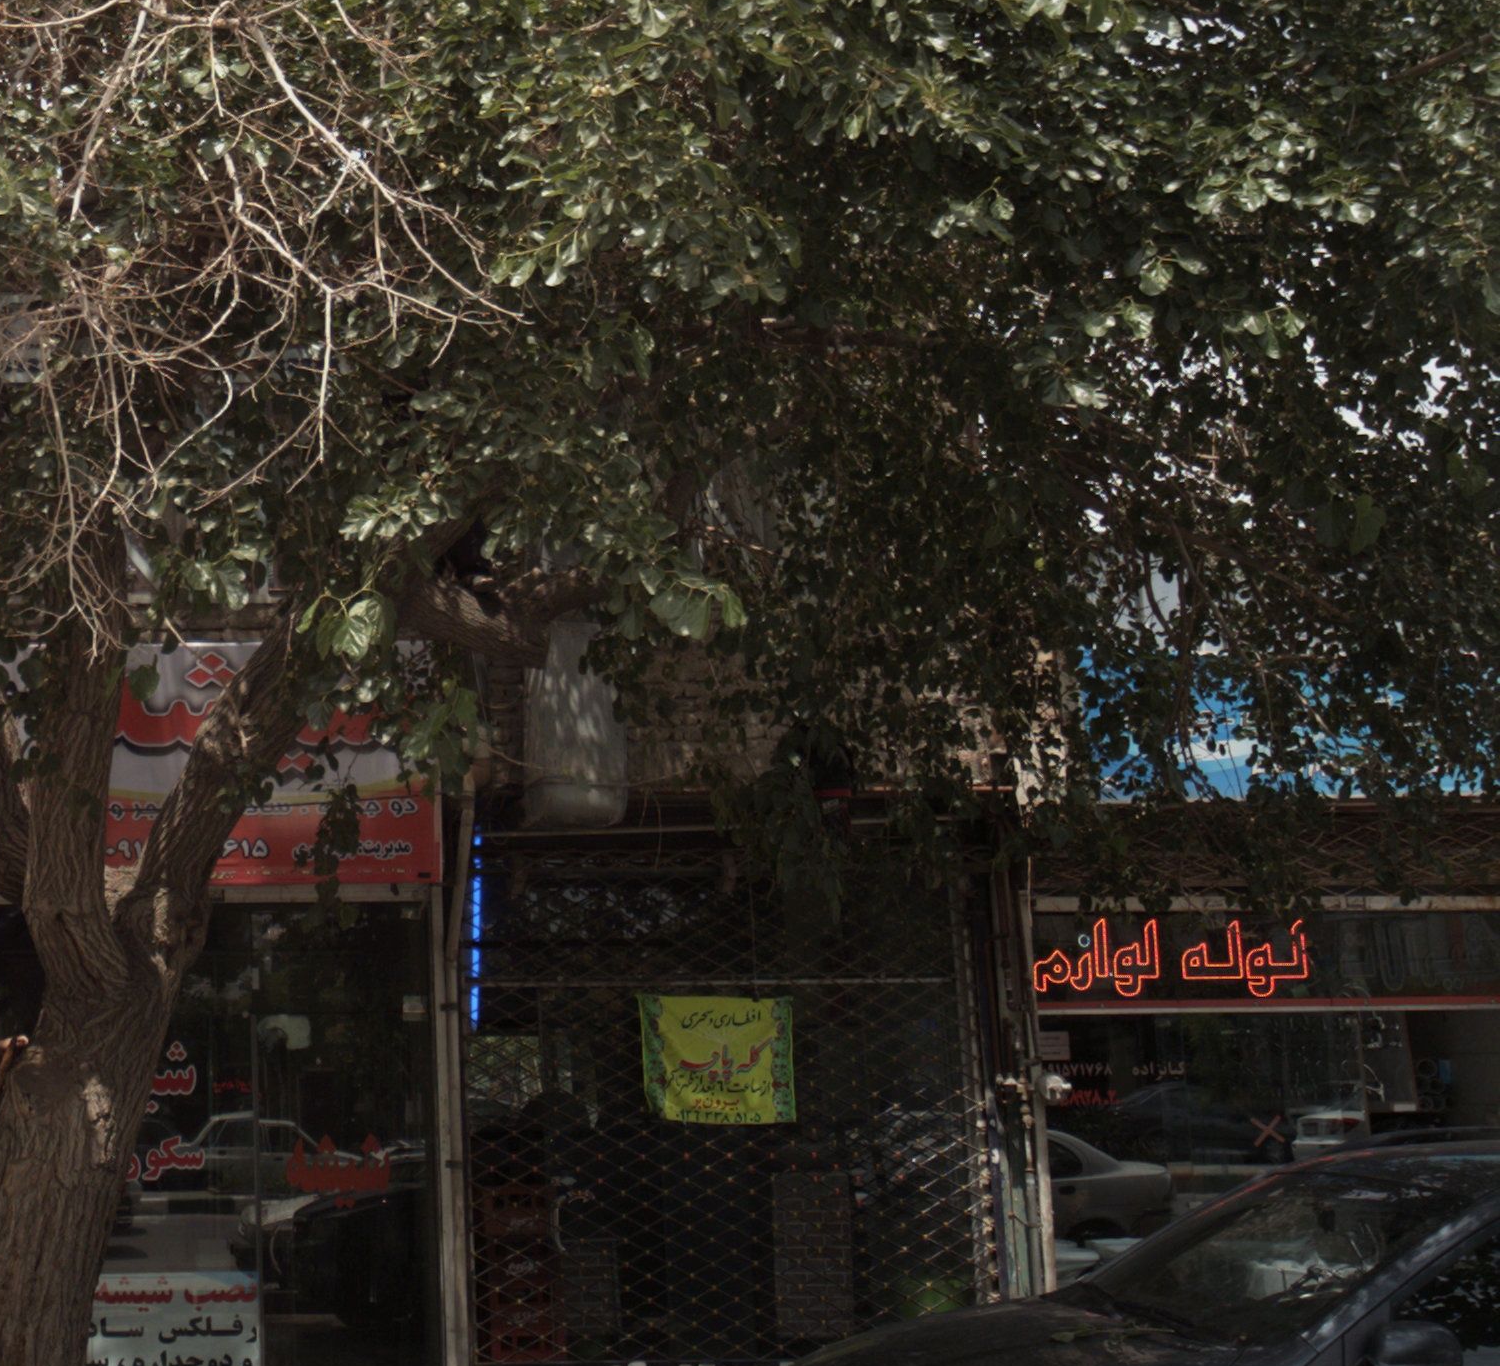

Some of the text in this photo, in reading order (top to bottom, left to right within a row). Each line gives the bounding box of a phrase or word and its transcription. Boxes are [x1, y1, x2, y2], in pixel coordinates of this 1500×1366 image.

[1033, 918, 1160, 998] لوازم
[714, 1009, 761, 1029] افطاری
[126, 1135, 206, 1181] سکور
[184, 1275, 258, 1312] نصب
